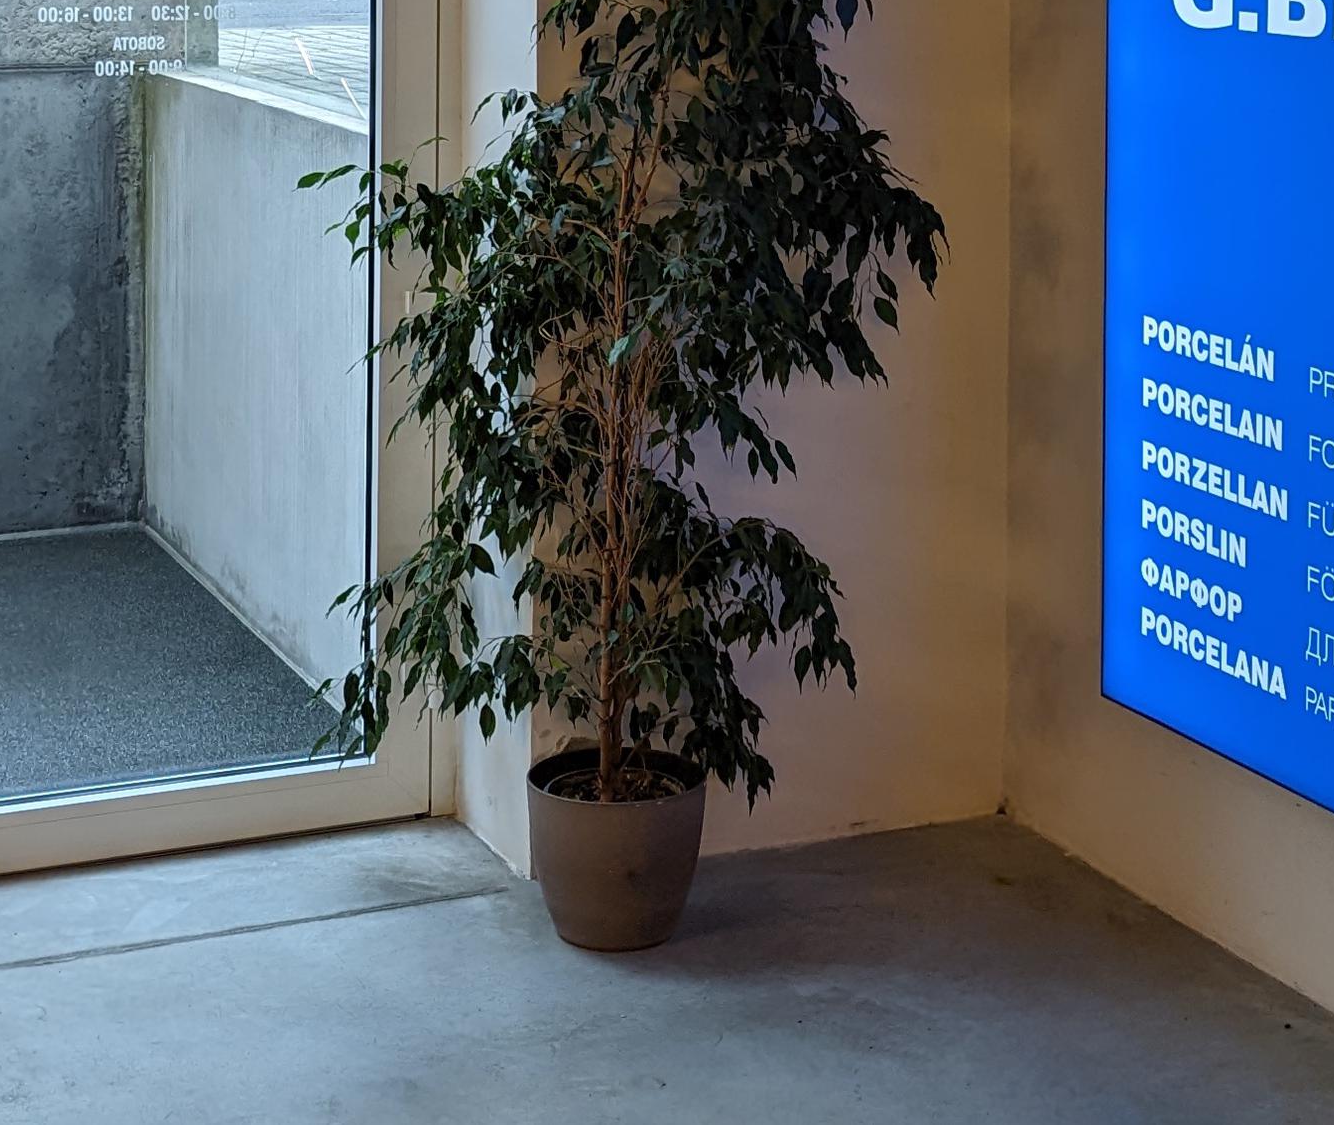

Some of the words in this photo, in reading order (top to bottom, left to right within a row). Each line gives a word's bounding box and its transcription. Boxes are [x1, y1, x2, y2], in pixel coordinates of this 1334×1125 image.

[1144, 316, 1274, 381] PORCELÁN
[1143, 378, 1282, 450] PORCELAIN
[1143, 441, 1287, 520] PORZELLAN
[1142, 499, 1245, 567] PORSLIN
[1142, 558, 1241, 621] ФАРФОР
[1142, 607, 1286, 699] PORCELANA
